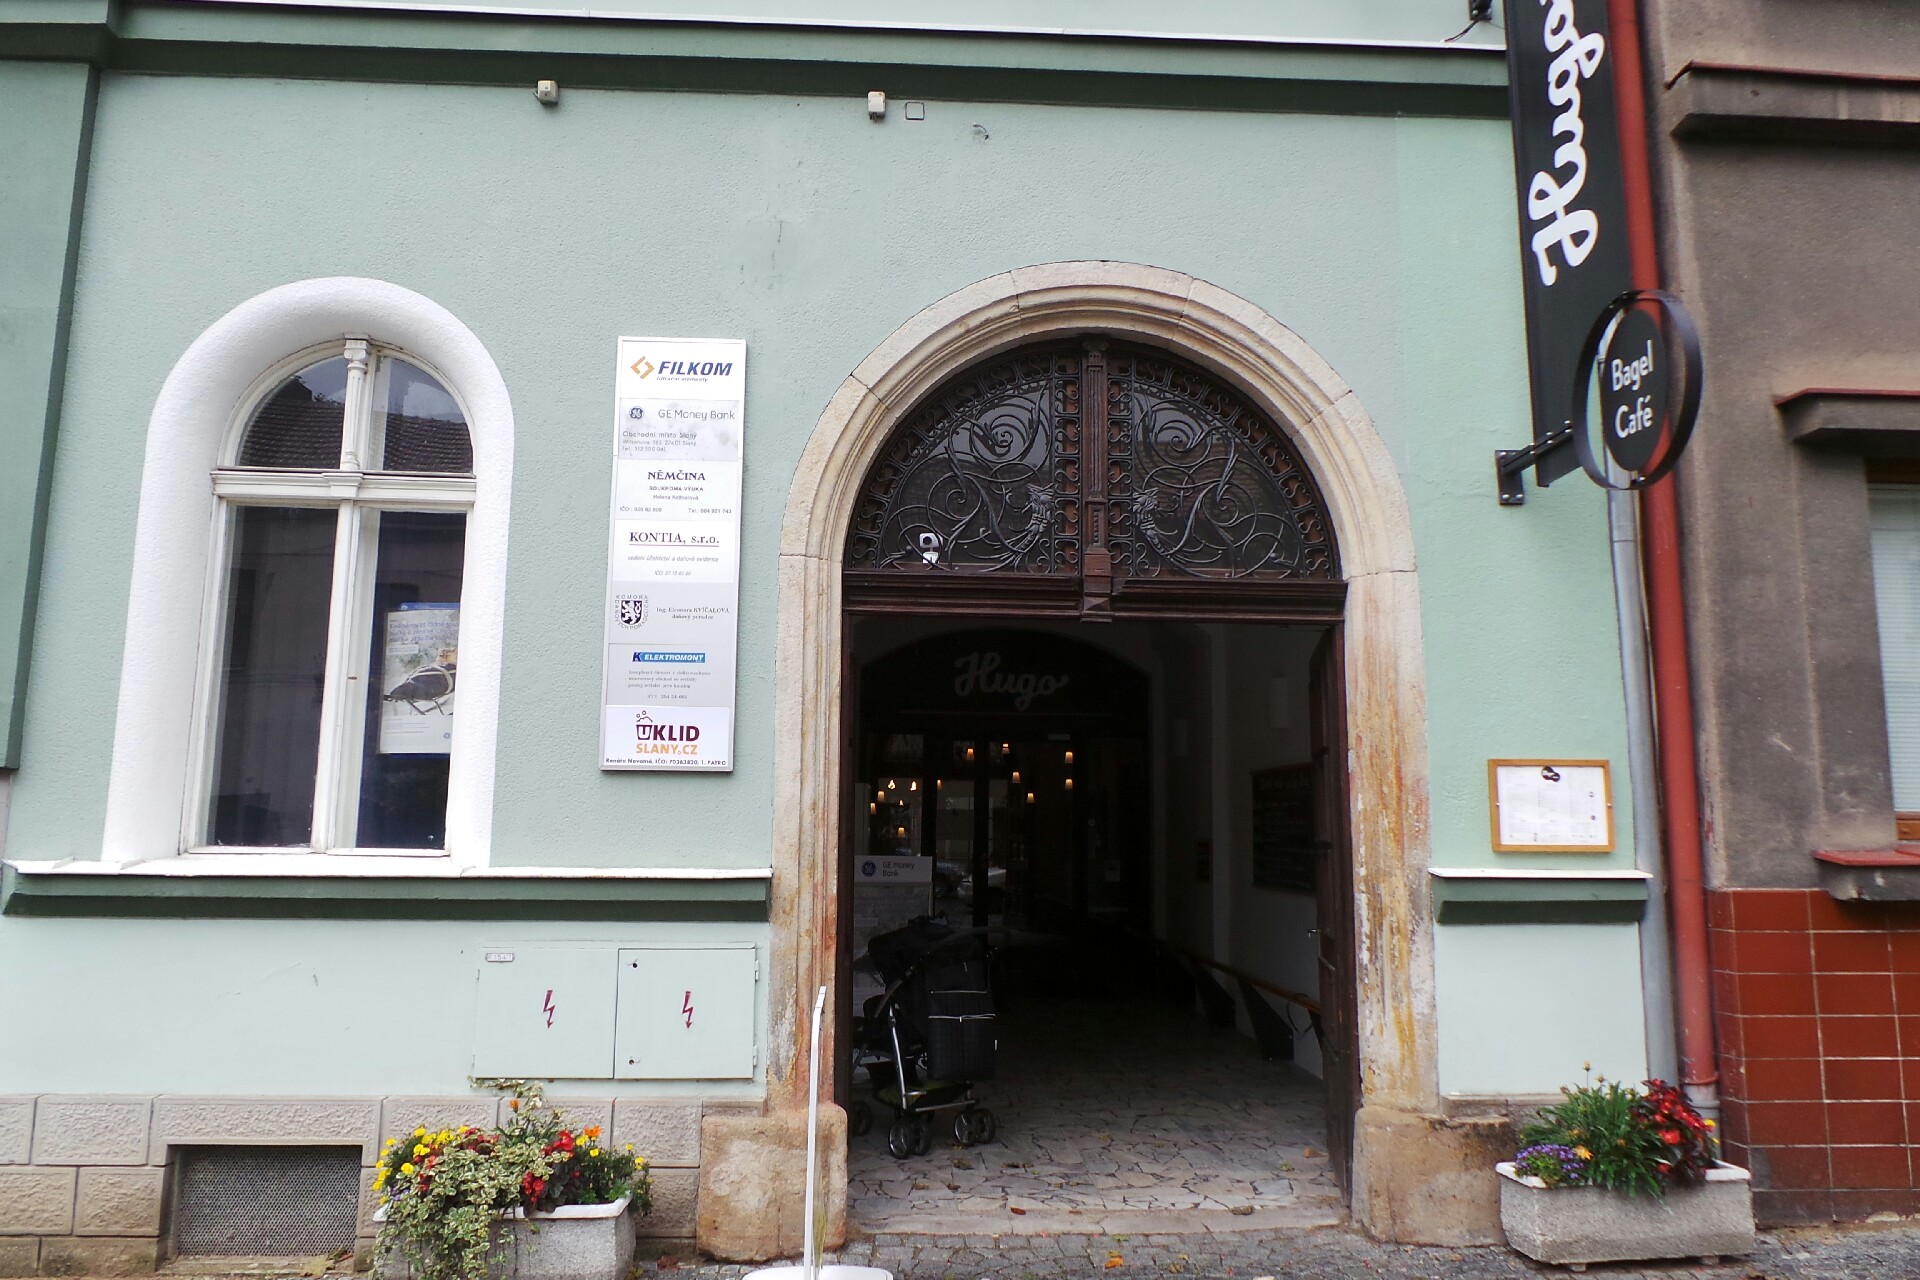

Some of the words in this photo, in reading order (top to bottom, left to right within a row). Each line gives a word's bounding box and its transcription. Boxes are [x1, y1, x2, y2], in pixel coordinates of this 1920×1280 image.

[1528, 0, 1604, 286] Hugo
[658, 361, 733, 376] FILKOM
[1612, 339, 1654, 392] Bagel
[657, 409, 672, 419] GE
[674, 409, 708, 422] Money
[710, 410, 736, 420] Bank
[1615, 395, 1653, 439] Café
[648, 469, 706, 481] NĚMČINA
[629, 531, 687, 544] KONTIA,
[690, 535, 720, 544] s.r.o.
[644, 653, 704, 661] ELEKTROMONT
[954, 652, 1070, 711] Hugo
[636, 724, 700, 742] UKLID
[636, 743, 699, 756] SLANY.CZ
[882, 861, 892, 869] GE
